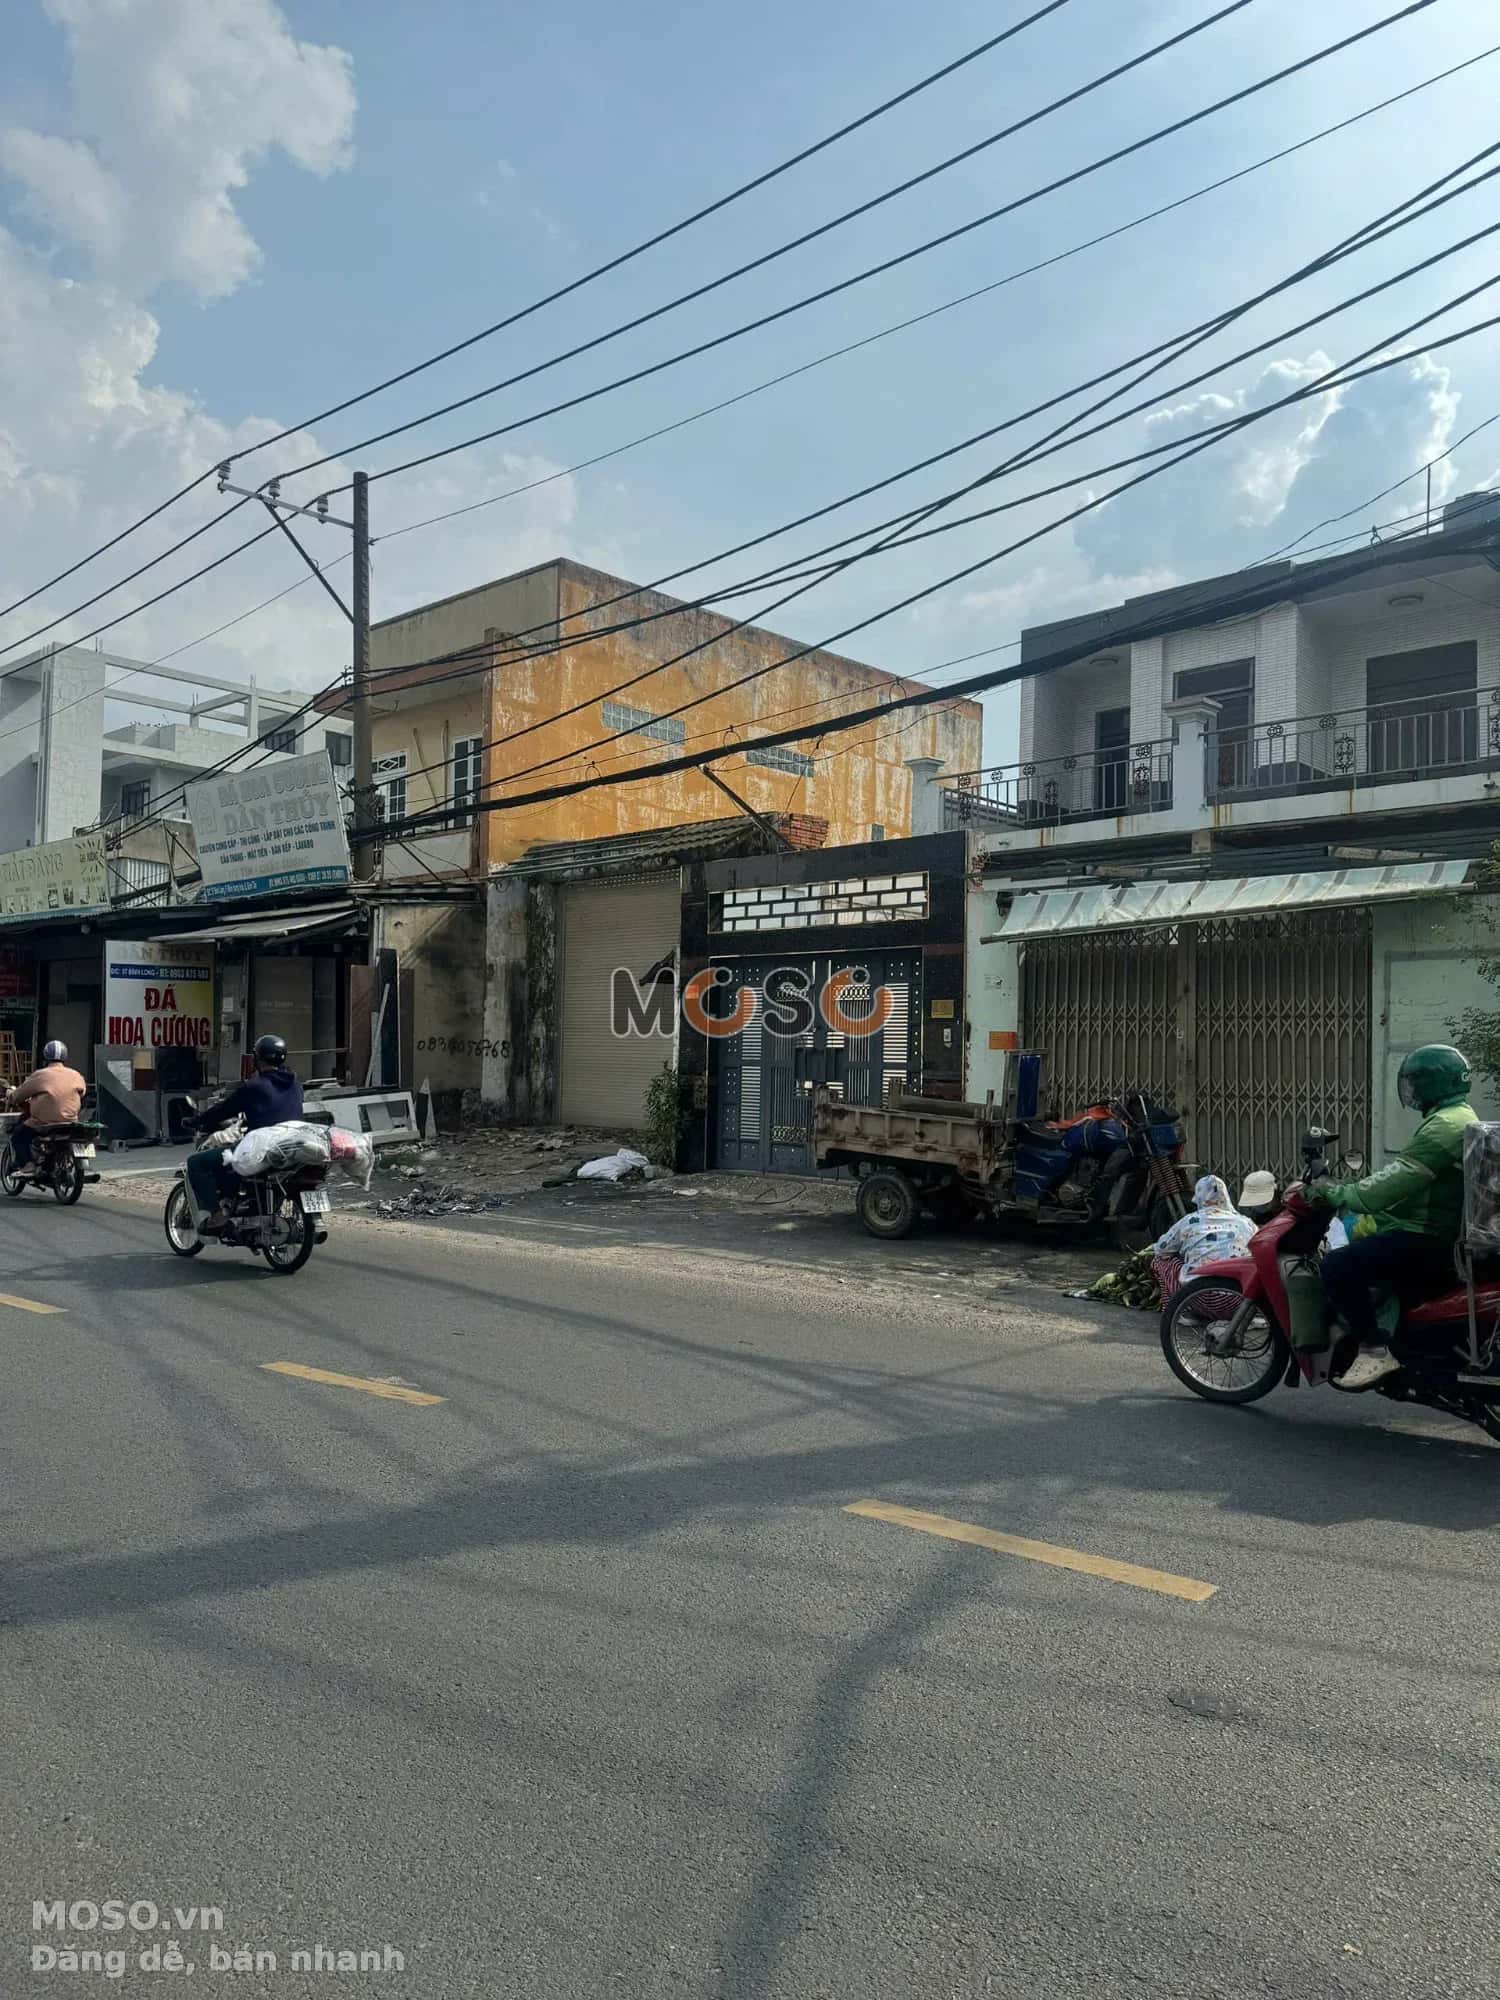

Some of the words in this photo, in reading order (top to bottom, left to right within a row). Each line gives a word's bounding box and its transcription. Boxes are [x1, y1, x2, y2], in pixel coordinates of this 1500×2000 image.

[144, 984, 178, 1012] ĐÁ
[109, 1016, 145, 1046] HOA
[151, 1013, 210, 1047] CƯƠNG
